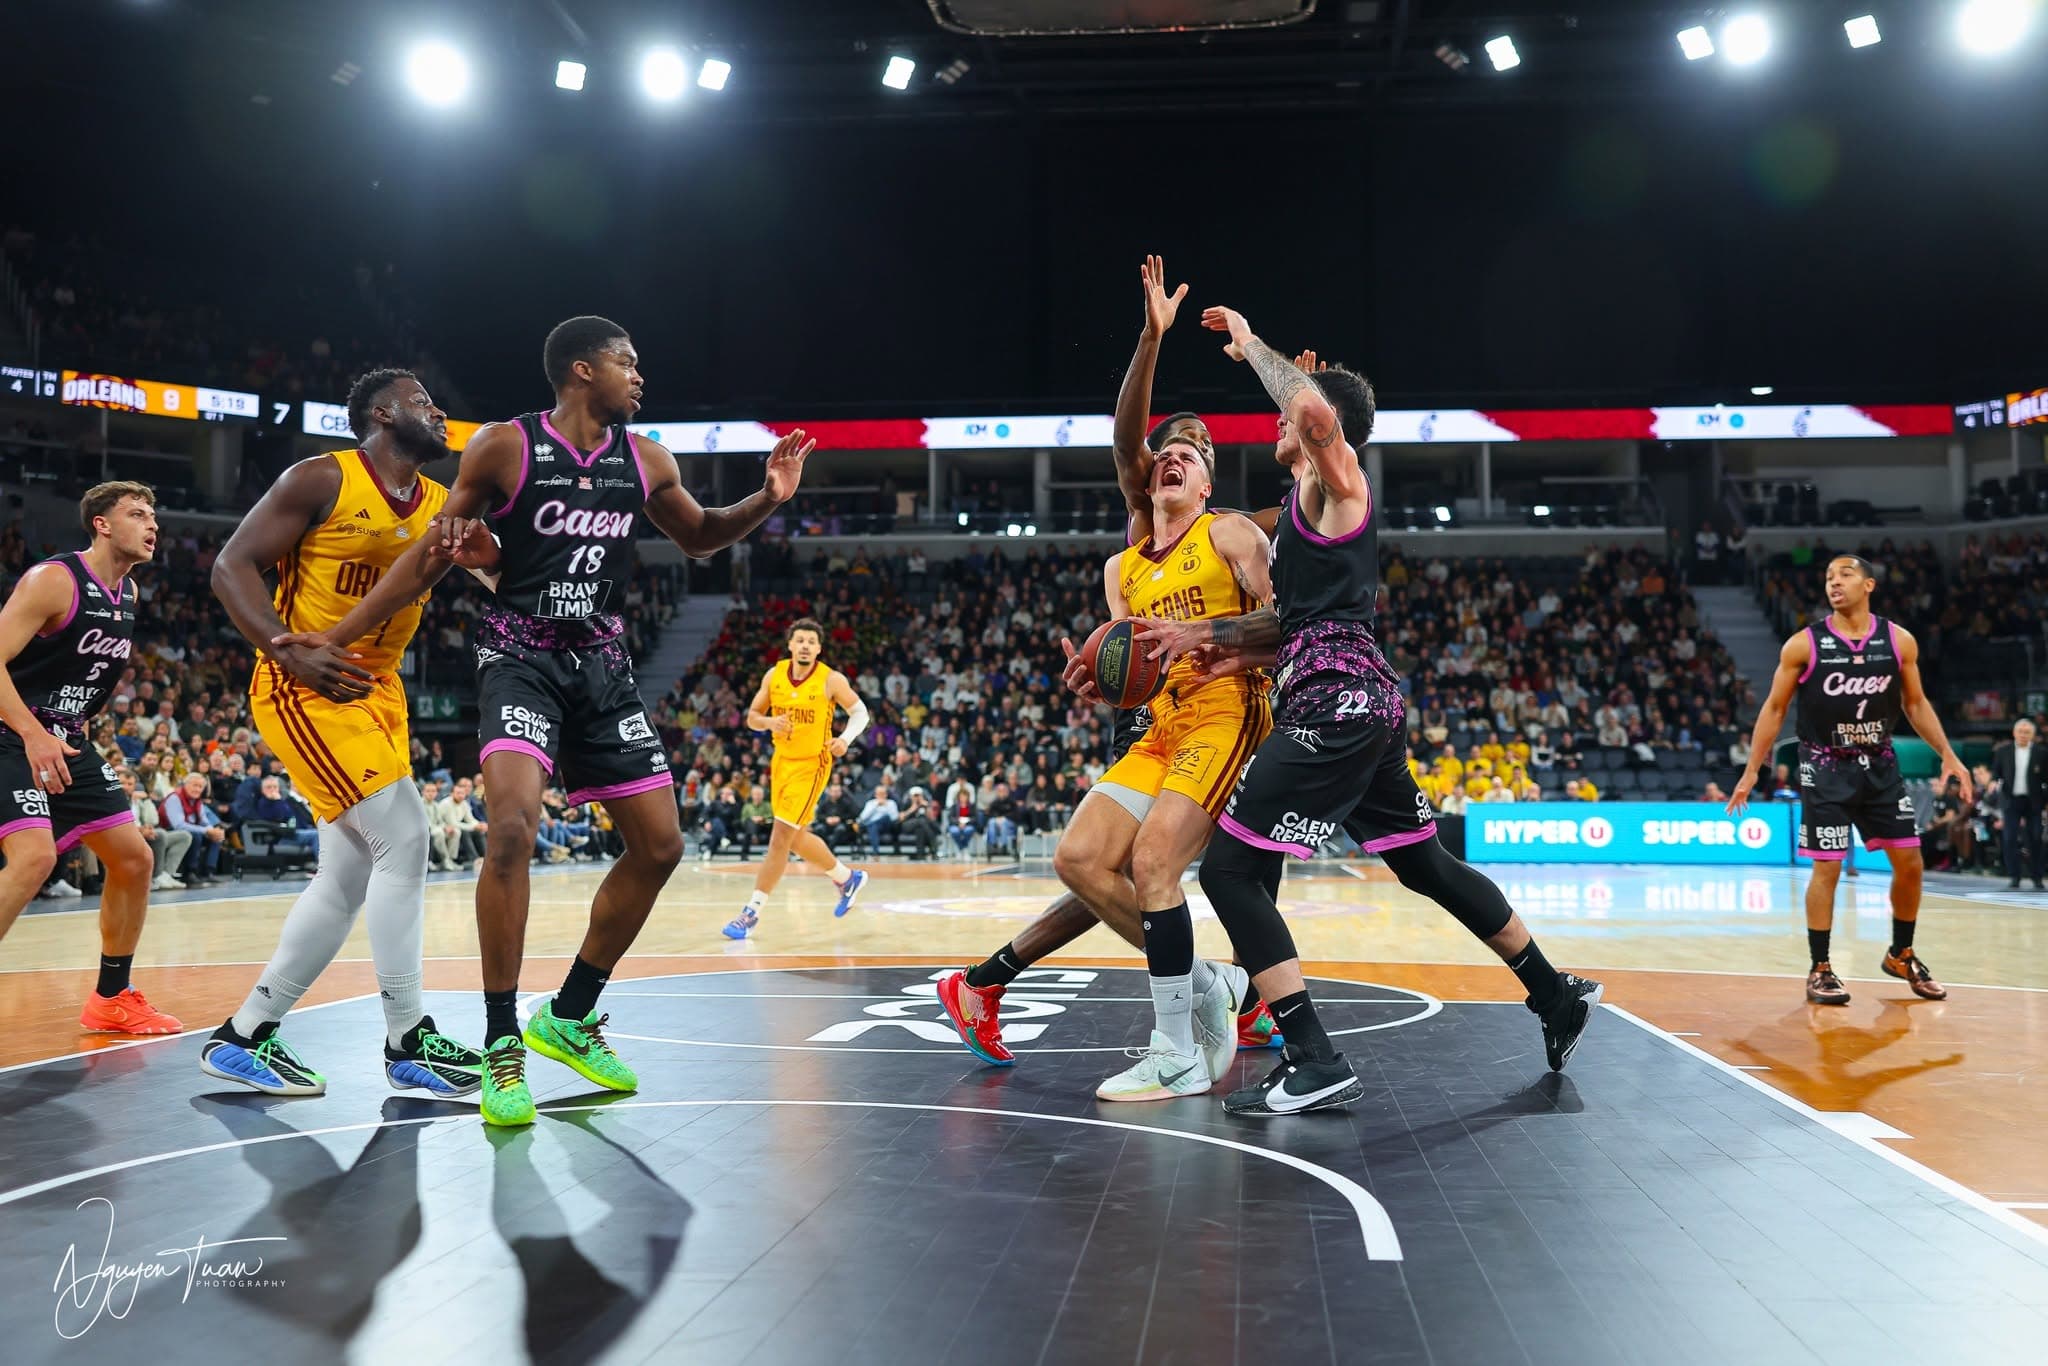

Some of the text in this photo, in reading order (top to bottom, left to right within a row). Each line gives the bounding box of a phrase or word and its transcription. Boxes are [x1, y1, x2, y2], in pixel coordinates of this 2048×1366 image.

[10, 379, 56, 396] 4 0
[62, 378, 147, 411] ORLEANS
[273, 402, 290, 424] 7
[320, 414, 351, 432] CB
[534, 500, 635, 540] Caen
[567, 544, 606, 575] 18
[86, 661, 109, 680] 5
[1336, 690, 1370, 714] 22
[1855, 698, 1868, 720] 1
[504, 720, 548, 748] CLUB
[1282, 811, 1336, 836] CAEN
[1484, 819, 1579, 844] HYPER
[1642, 820, 1736, 845] SUPER
